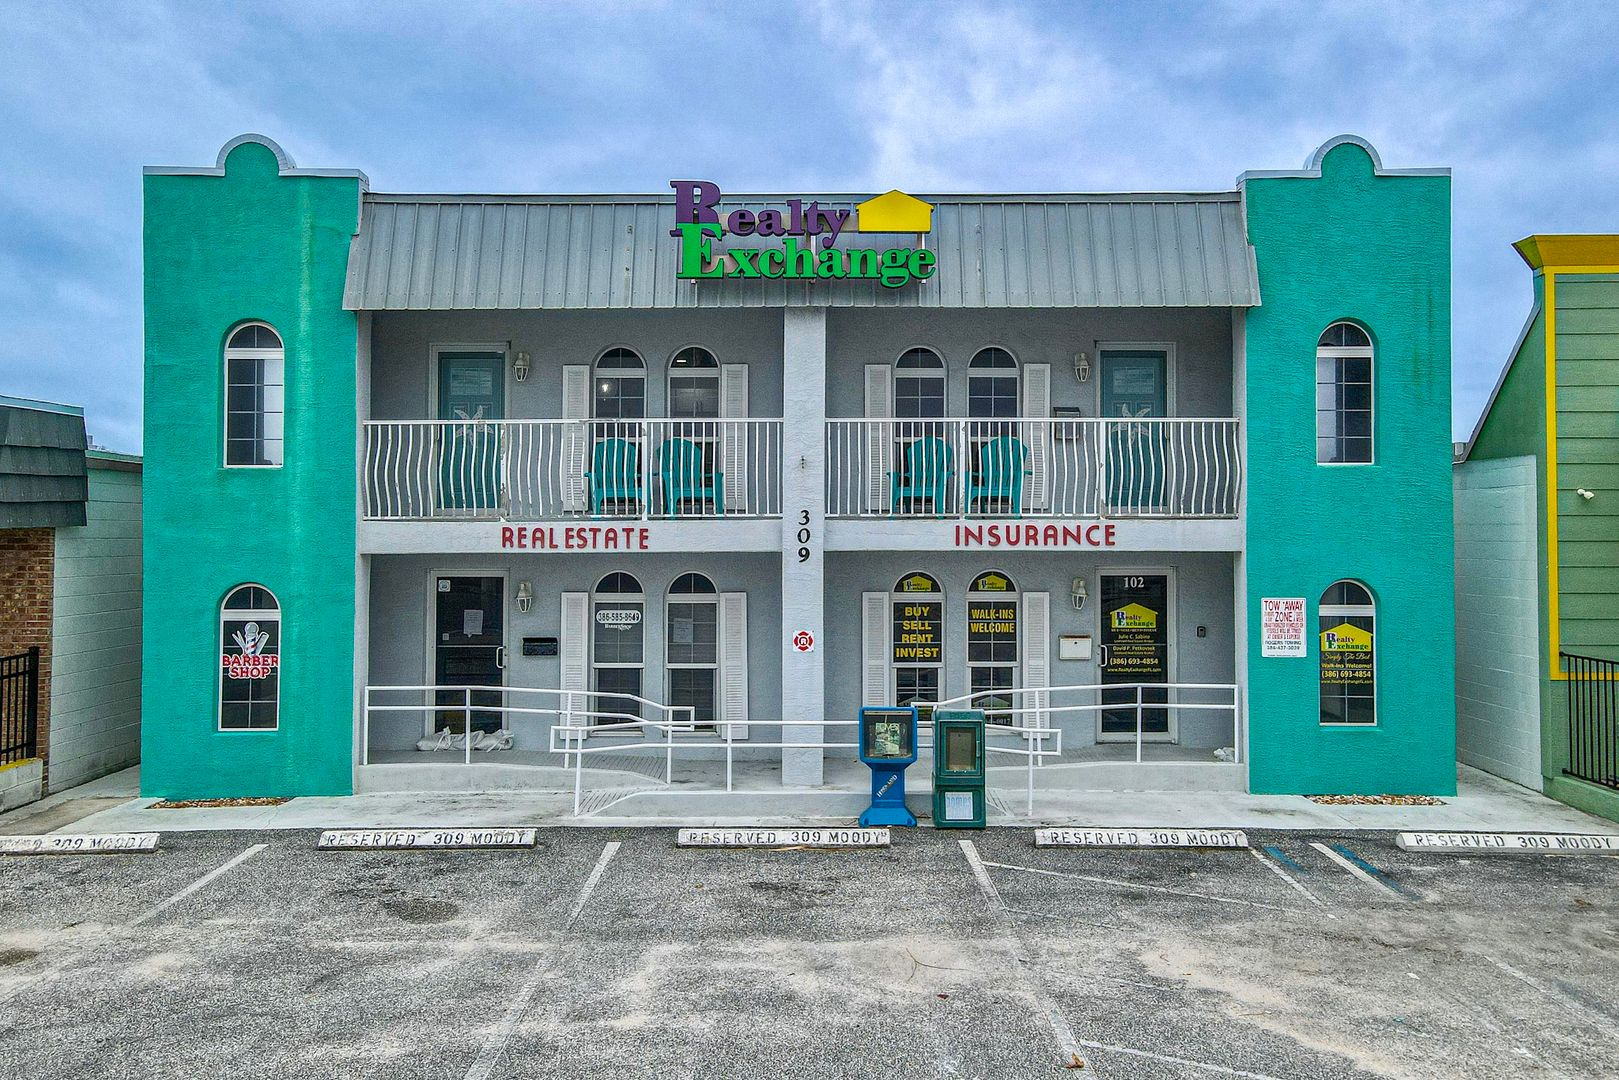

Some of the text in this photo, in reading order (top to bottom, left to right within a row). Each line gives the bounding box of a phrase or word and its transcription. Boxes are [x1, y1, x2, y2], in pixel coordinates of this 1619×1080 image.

[670, 180, 850, 248] Realty
[676, 223, 937, 288] Exchange
[797, 509, 811, 563] 309
[955, 524, 1116, 547] INSURANCE
[1123, 577, 1145, 588] 102
[904, 606, 930, 617] BUY
[971, 608, 1014, 621] WALK-INS
[1116, 611, 1143, 621] Realty
[1274, 611, 1293, 622] ZONE
[902, 620, 932, 631] SELL
[970, 622, 1015, 634] WELCOME
[1118, 619, 1154, 627] Exchange
[901, 633, 934, 644] RENT
[1325, 632, 1355, 643] Realty
[1327, 640, 1369, 650] Exchange
[896, 647, 939, 658] INVEST
[222, 655, 278, 667] BARBER
[1109, 657, 1128, 667] (386)
[230, 667, 270, 677] SHOP
[1321, 670, 1372, 679] (386) 693-4854
[326, 832, 526, 846] RESERVED 309 MOODY
[688, 831, 888, 844] RESERVED 309 MOODY
[1050, 831, 1242, 846] RESERVED 309 MOODY
[1414, 834, 1612, 849] RESERVED 309 MOODY
